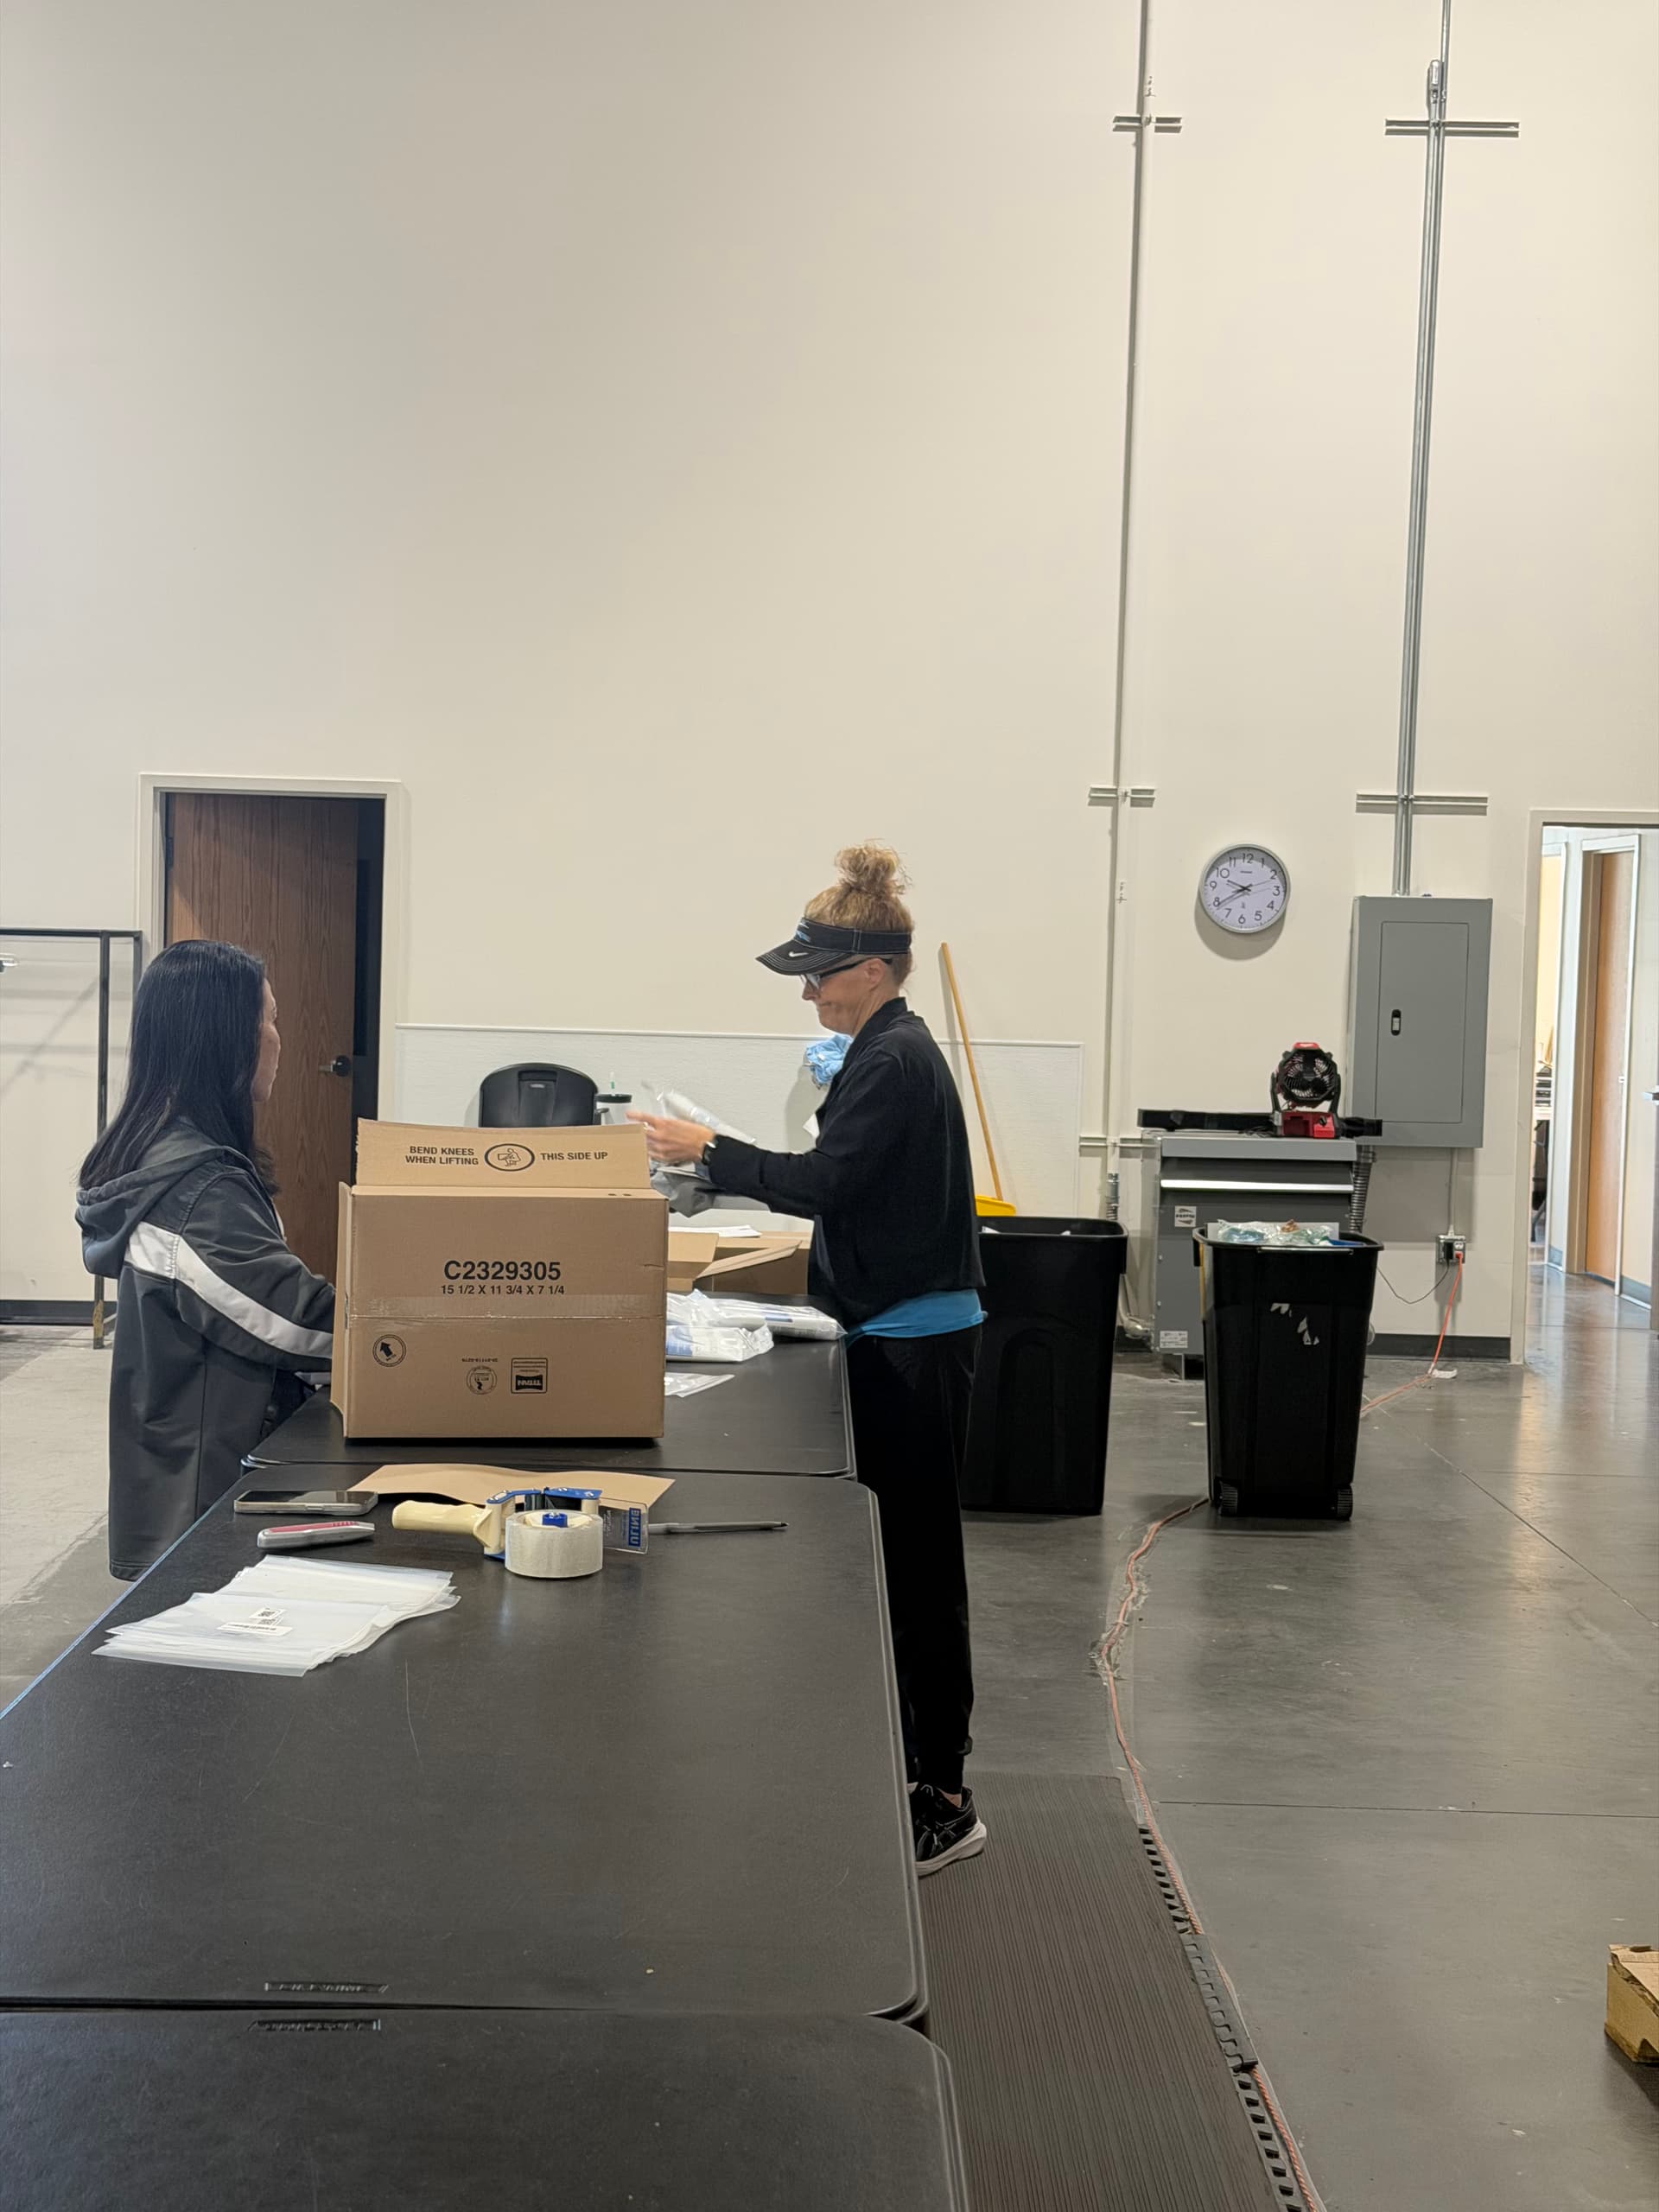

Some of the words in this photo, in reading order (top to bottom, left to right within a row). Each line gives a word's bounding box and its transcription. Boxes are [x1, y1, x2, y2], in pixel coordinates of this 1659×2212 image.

[1229, 857, 1236, 868] 11
[1243, 853, 1254, 864] 12
[1216, 868, 1230, 879] 10
[1269, 869, 1277, 880] 2
[1210, 880, 1217, 891] 9
[1272, 886, 1281, 896] 3
[1213, 897, 1220, 906] 8
[1267, 900, 1274, 911] 4
[1224, 908, 1232, 918] 7
[1254, 911, 1262, 921] 5
[1238, 914, 1246, 925] 6
[410, 1146, 437, 1154] BEND
[441, 1147, 474, 1156] KNEES
[540, 1152, 564, 1160] THIS
[567, 1152, 592, 1160] SIDE
[594, 1151, 608, 1160] UP
[405, 1155, 436, 1164] WHEN
[439, 1157, 479, 1166] LIFTING
[443, 1260, 562, 1281] C2329305
[442, 1285, 454, 1294] 15
[458, 1285, 475, 1294] 1/2
[478, 1285, 486, 1294] X
[490, 1285, 501, 1294] 11
[505, 1285, 523, 1294] 3/4
[526, 1286, 535, 1295] X
[537, 1286, 544, 1295] 7
[548, 1285, 565, 1295] 1/4
